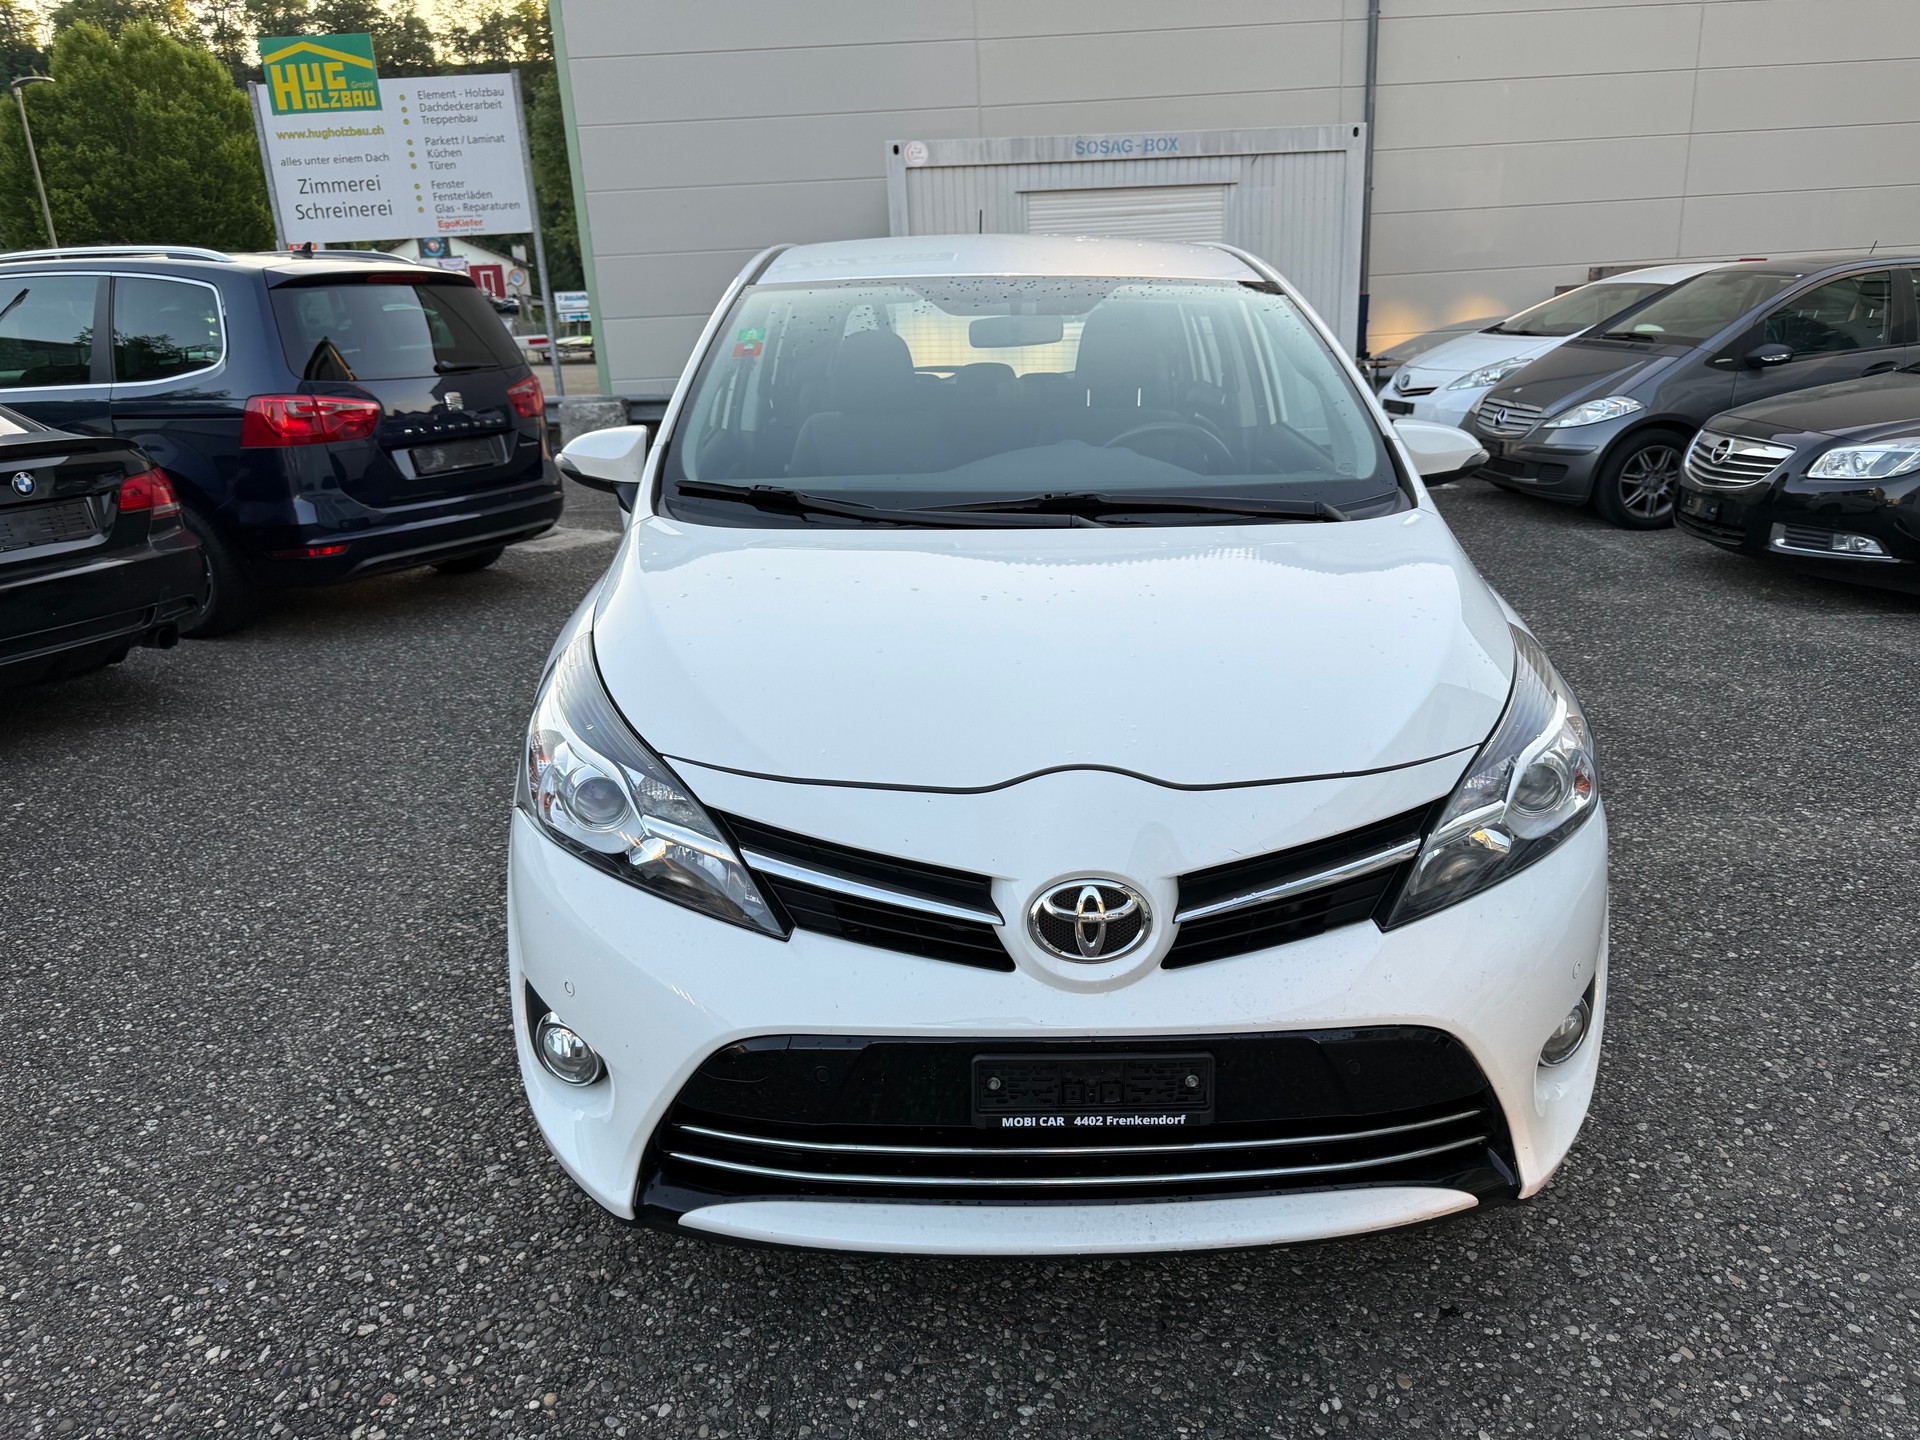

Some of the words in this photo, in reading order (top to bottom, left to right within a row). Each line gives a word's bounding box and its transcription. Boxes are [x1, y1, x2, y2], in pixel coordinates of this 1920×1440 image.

[270, 62, 347, 110] HUG
[417, 90, 456, 100] Element
[464, 88, 504, 98] Holzbau
[419, 99, 503, 112] Dachdeckerarbeit
[421, 114, 478, 125] Treppenbau
[276, 125, 385, 140] www.hugholzbau.ch
[424, 136, 460, 146] Parkett
[466, 134, 505, 144] Laminat
[427, 148, 462, 158] Küchen
[280, 157, 302, 167] alles
[304, 156, 330, 165] unter
[333, 154, 363, 164] einem
[365, 152, 390, 163] Dach
[428, 160, 456, 170] Türen
[297, 174, 382, 195] Zimmerei
[431, 180, 465, 189] Fenster
[432, 190, 493, 201] Fensterläden
[295, 199, 393, 220] Schreinerei
[435, 204, 455, 213] Glas
[462, 202, 521, 213] Reparaturen
[1002, 1117, 1036, 1127] MOBI
[1039, 1116, 1065, 1127] CAR
[1074, 1116, 1103, 1126] 4402
[1106, 1114, 1186, 1125] Frenkendorf
